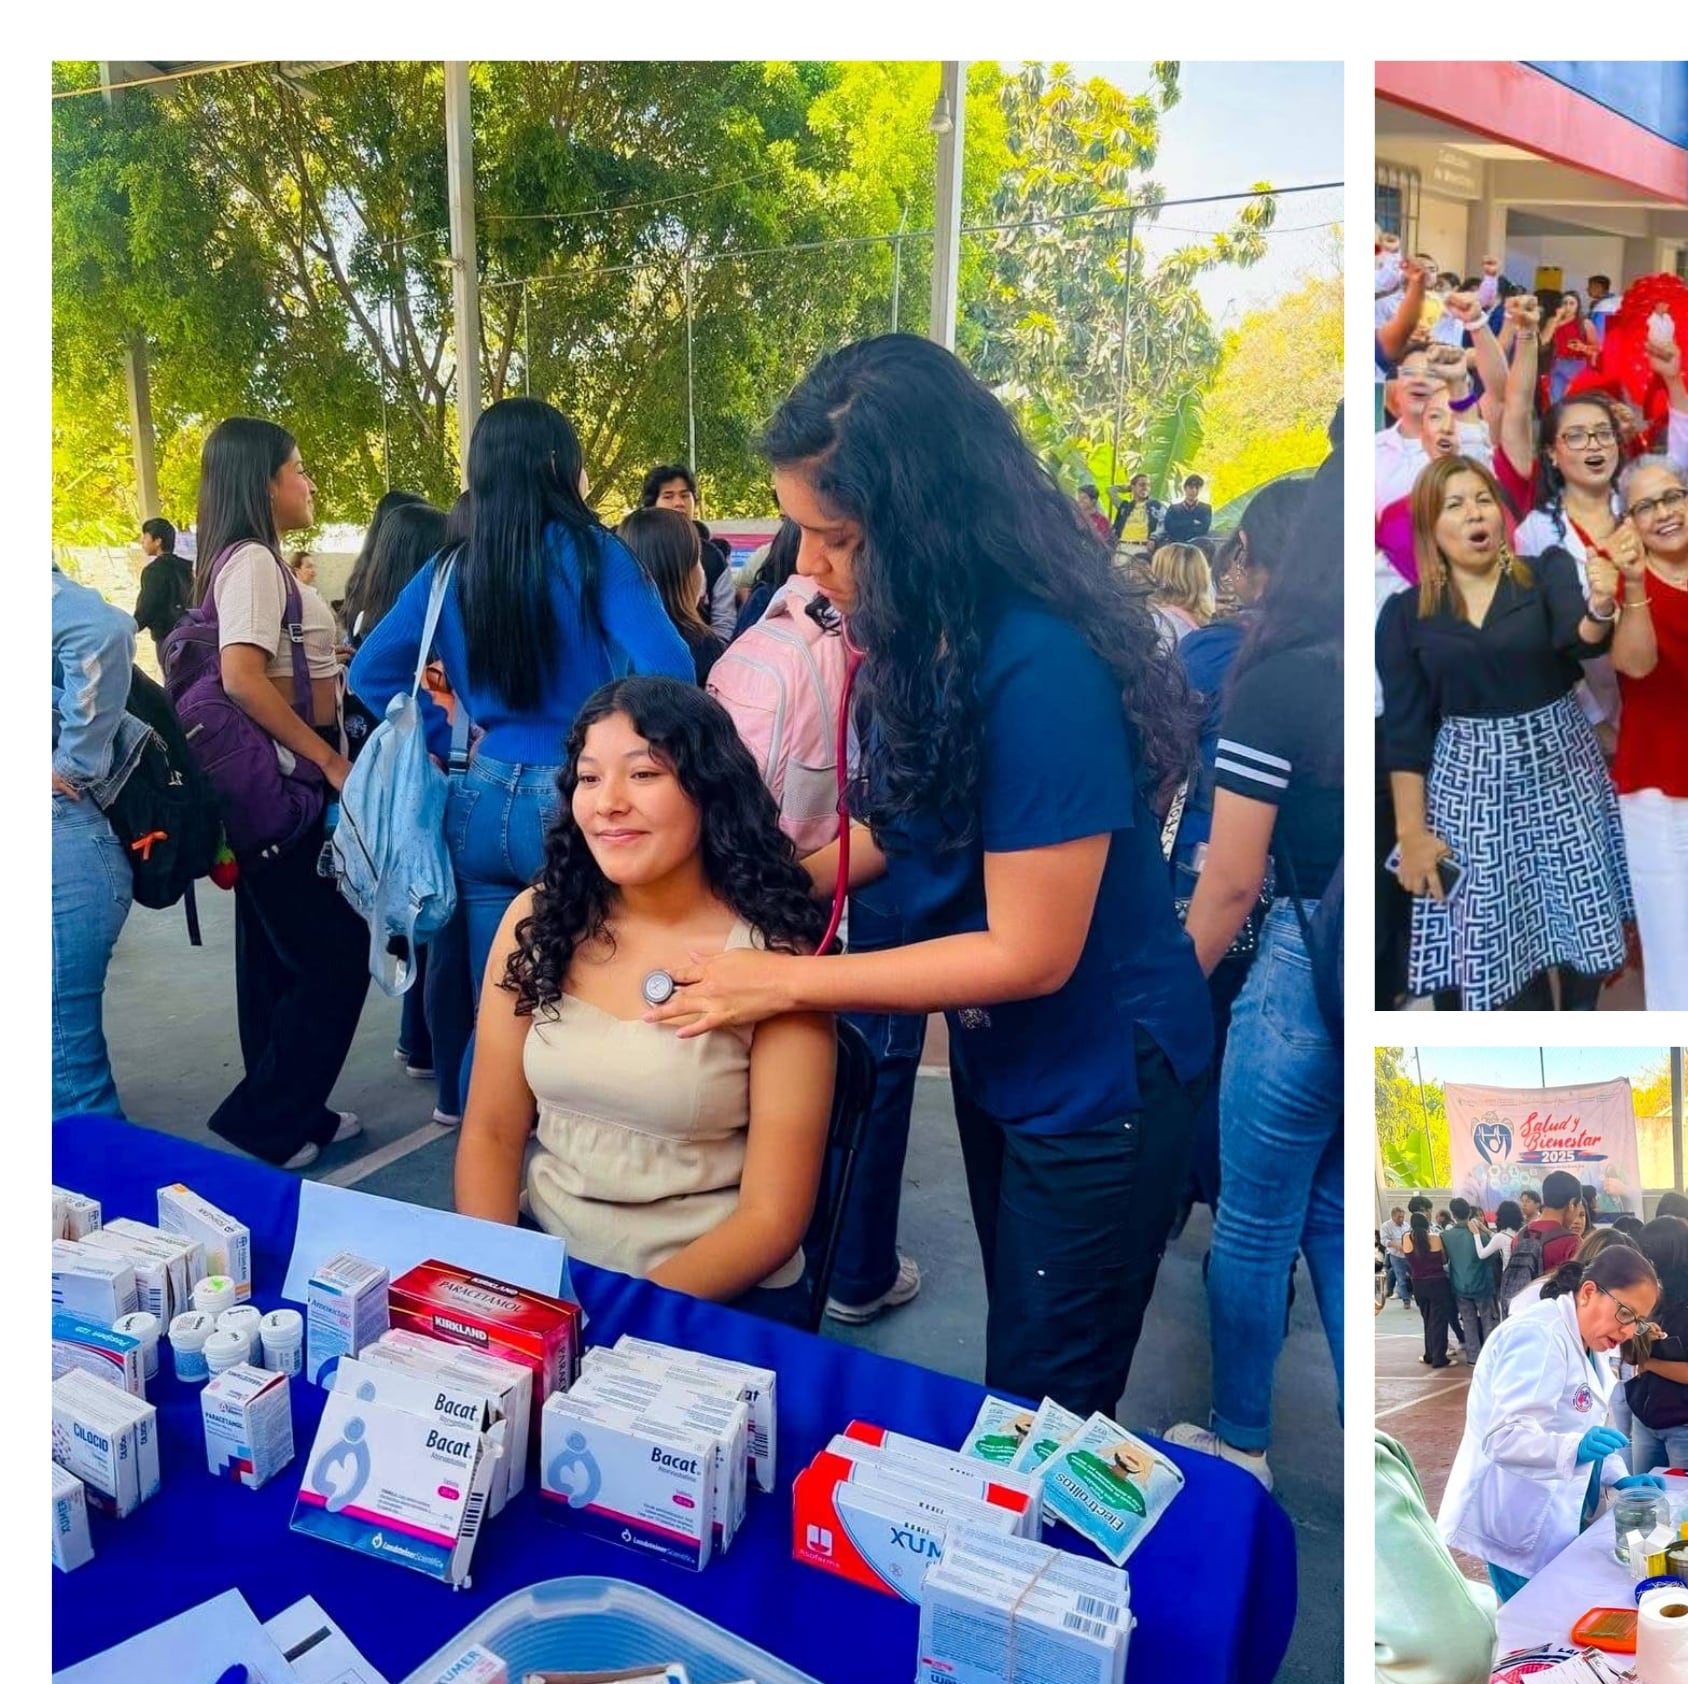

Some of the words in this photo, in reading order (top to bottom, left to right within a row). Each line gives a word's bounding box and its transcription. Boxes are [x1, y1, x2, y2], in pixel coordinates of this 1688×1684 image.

[1520, 1112, 1571, 1137] Salud
[1571, 1117, 1580, 1132] y
[1523, 1130, 1602, 1151] Bienestar
[1541, 1151, 1575, 1163] 2025
[439, 1280, 523, 1313] PARACETAMOL
[472, 1277, 519, 1296] KIRKLAND
[434, 1316, 488, 1342] KIRKLAND
[434, 1393, 477, 1422] Bacat
[73, 1423, 109, 1453] CILOCID
[426, 1429, 471, 1458] Bacat
[651, 1447, 698, 1474] Bacat
